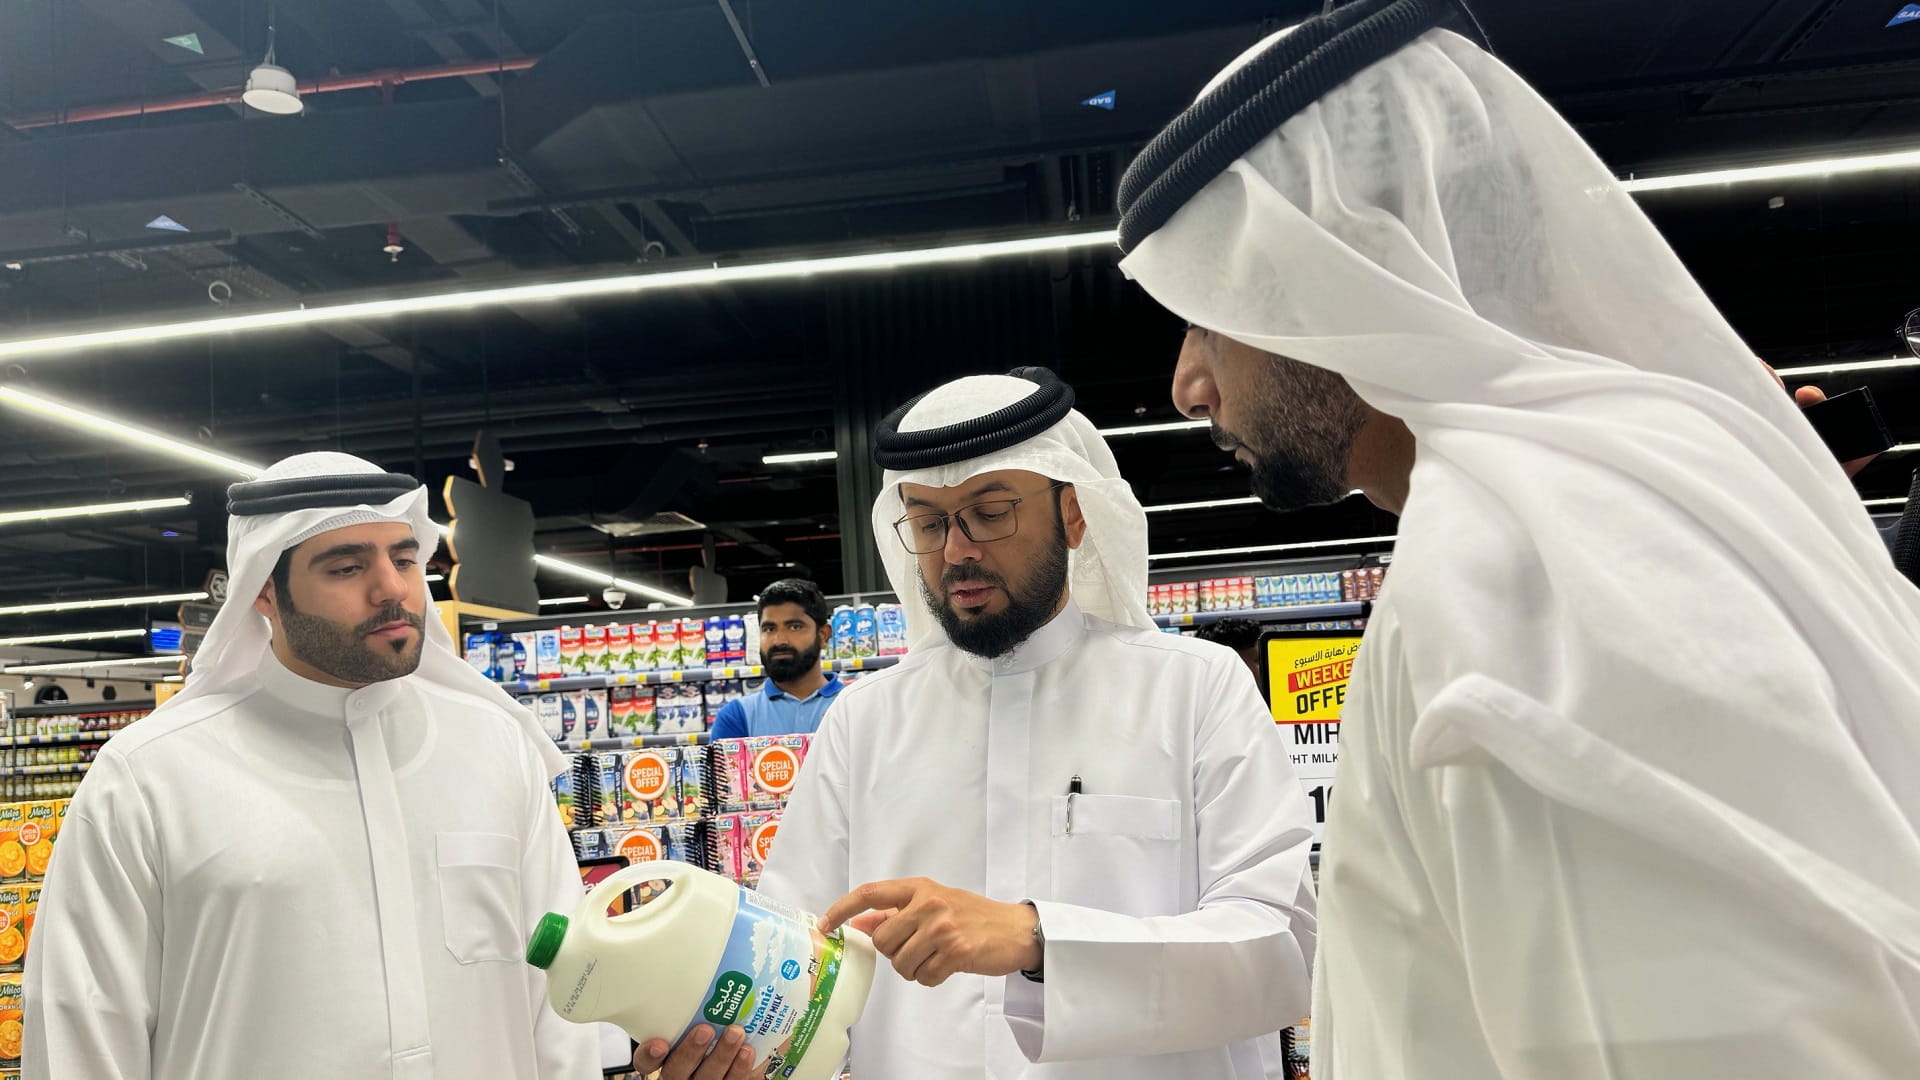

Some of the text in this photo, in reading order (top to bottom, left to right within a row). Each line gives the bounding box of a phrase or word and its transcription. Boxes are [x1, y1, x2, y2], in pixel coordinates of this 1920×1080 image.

[1296, 660, 1353, 689] WEEKE
[1296, 684, 1346, 715] OFFE
[1294, 722, 1340, 744] MIH
[631, 766, 662, 779] SPECIAL
[761, 760, 792, 772] SPECIAL
[766, 771, 789, 782] OFFER
[635, 777, 660, 789] OFFER
[1308, 786, 1332, 823] 1
[622, 845, 655, 857] SPECIAL
[709, 980, 735, 1016] مليحة
[723, 983, 747, 1020] meliha
[744, 985, 774, 1034] Organic
[758, 993, 784, 1036] FRESH MILK
[771, 1017, 783, 1034] Full
